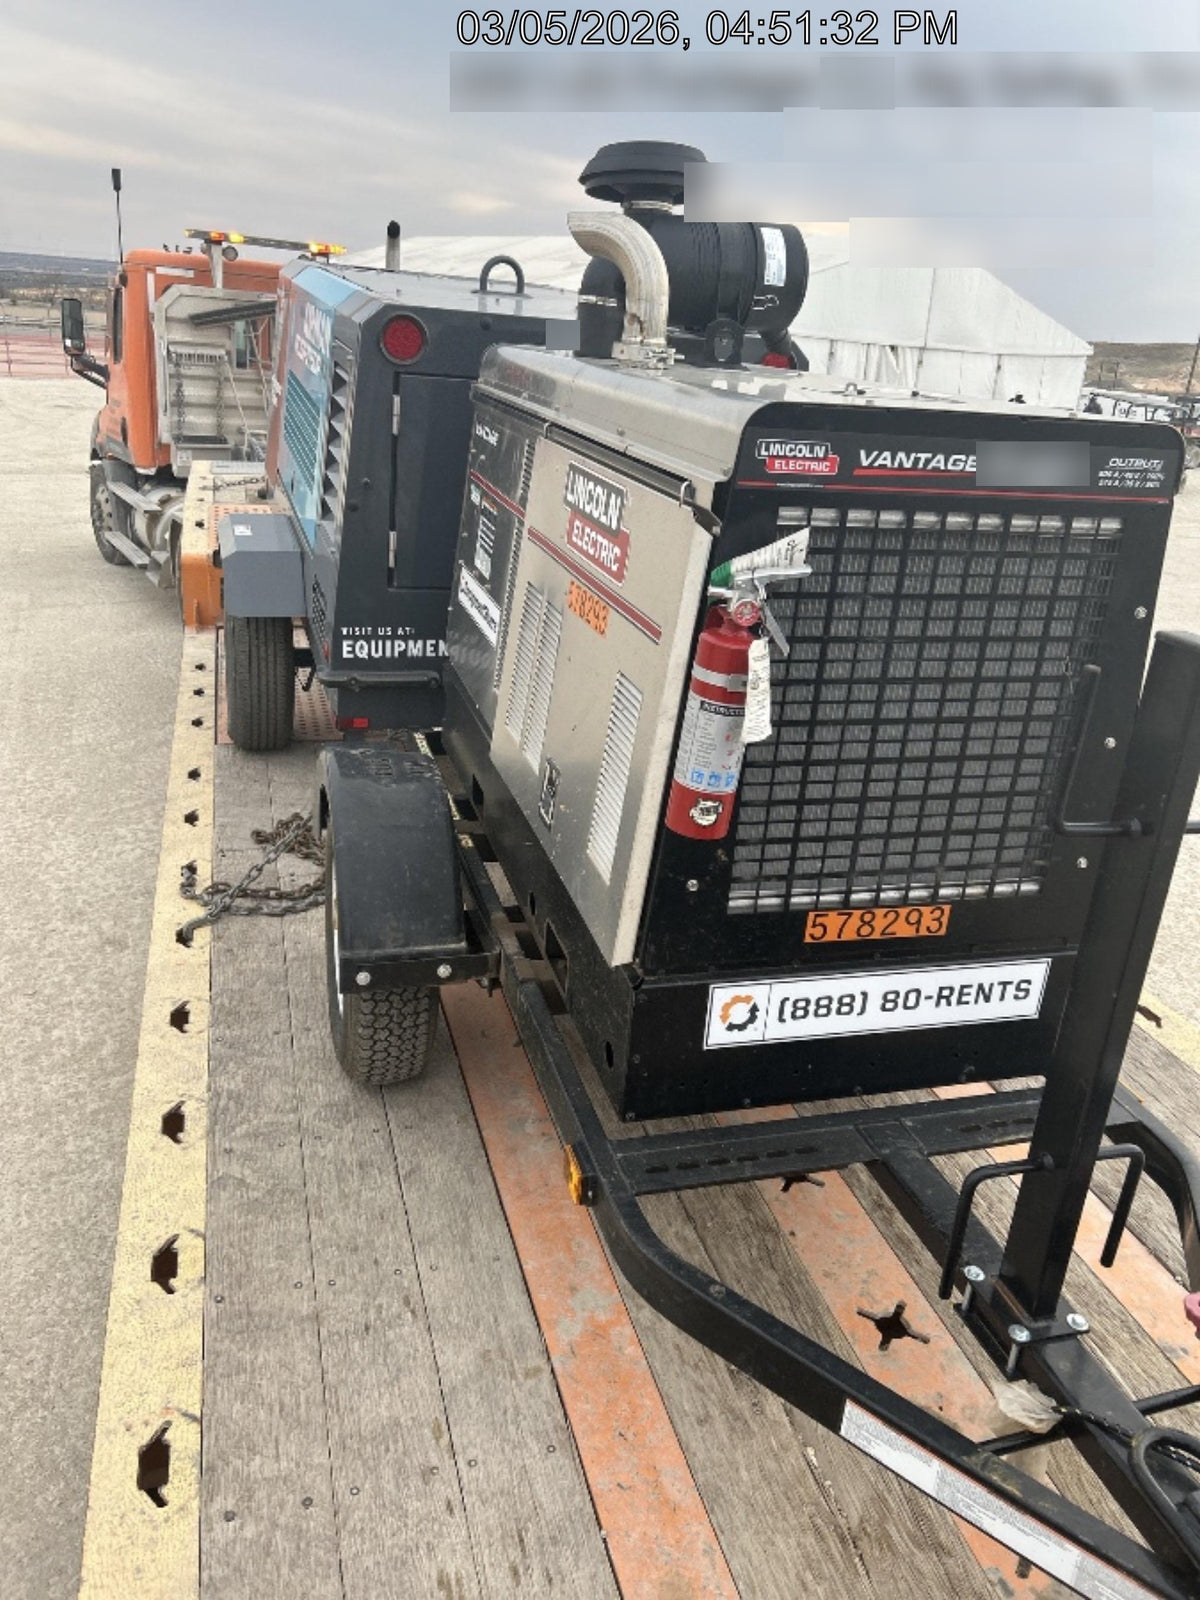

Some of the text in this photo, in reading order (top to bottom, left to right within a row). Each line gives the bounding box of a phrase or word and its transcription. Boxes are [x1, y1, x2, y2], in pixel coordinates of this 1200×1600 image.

[760, 442, 826, 458] LINCOLN
[774, 459, 831, 472] ELECTRIC
[1108, 458, 1161, 469] OUTPUT
[566, 470, 621, 531] LINCOLN
[571, 518, 621, 572] ELECTRIC
[341, 627, 372, 636] VISIT
[378, 627, 392, 636] US
[808, 906, 946, 941] 578293
[778, 979, 1033, 1023] (888) 80-RENTS
